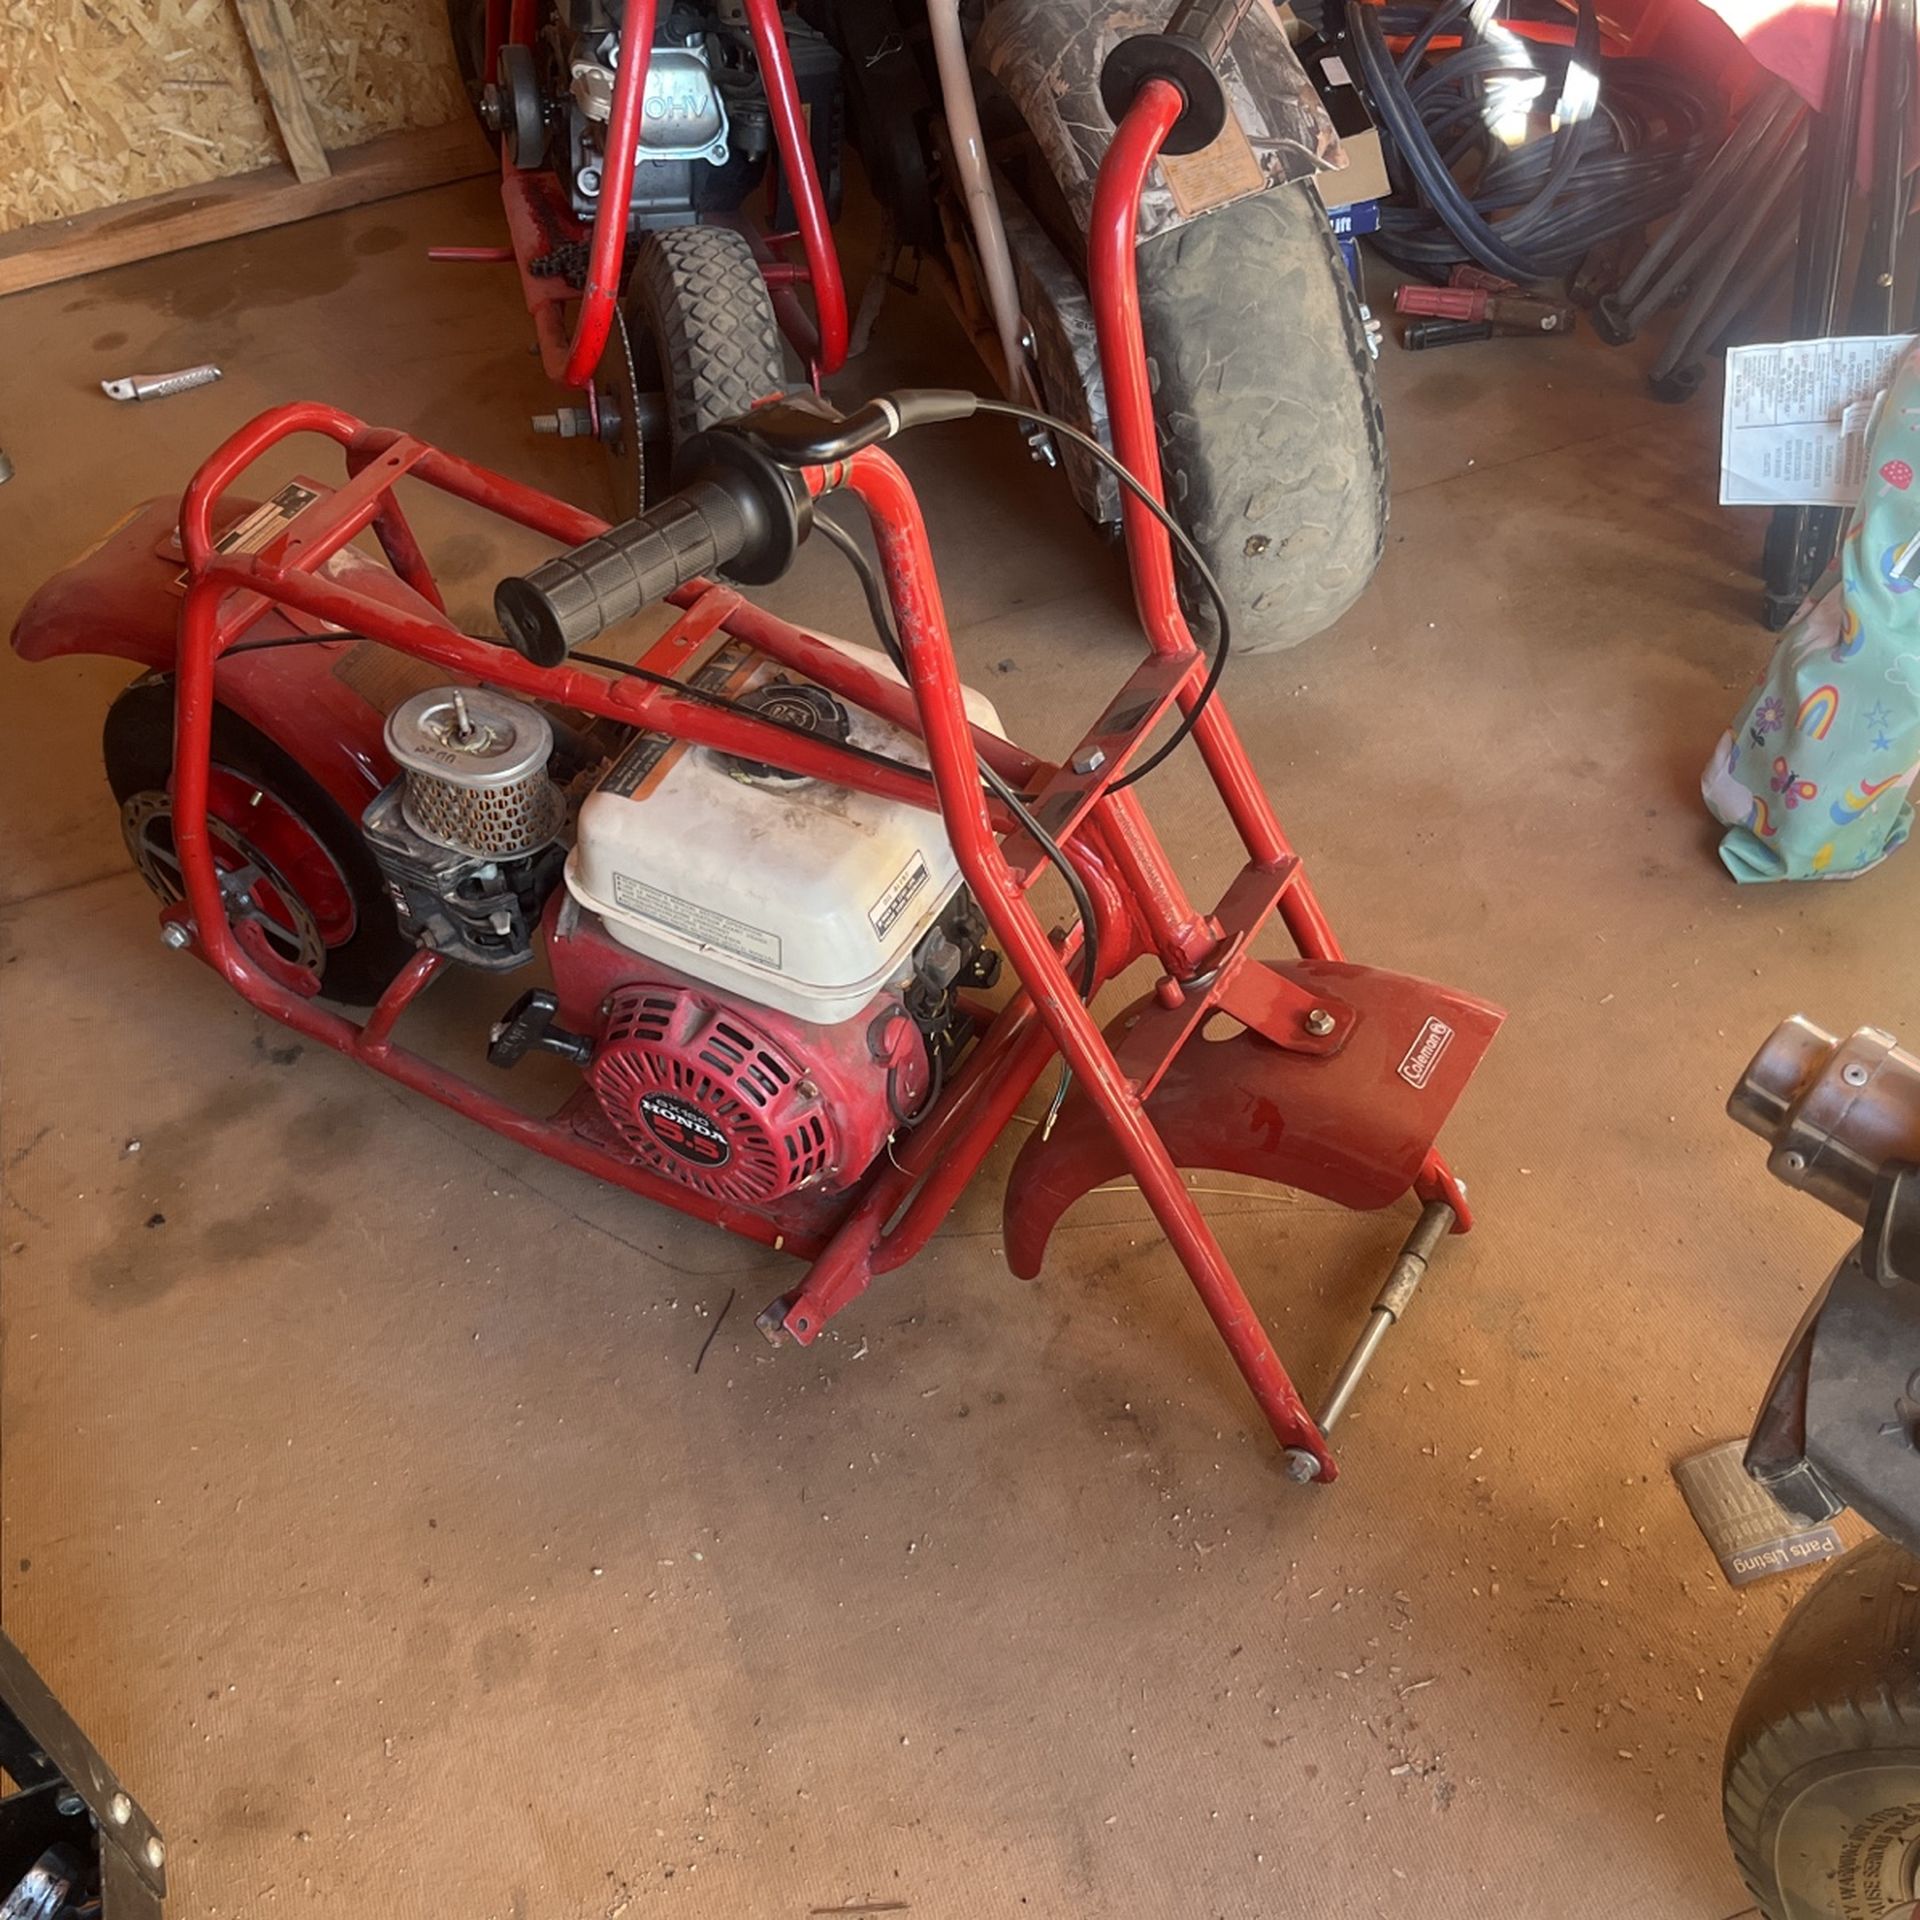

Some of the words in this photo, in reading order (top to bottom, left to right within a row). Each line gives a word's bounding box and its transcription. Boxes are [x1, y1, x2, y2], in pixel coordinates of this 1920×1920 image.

[645, 95, 708, 119] OHV
[1403, 1033, 1442, 1079] Coleman
[641, 1099, 728, 1145] HONDA
[653, 1115, 719, 1159] 5.5
[1732, 1548, 1790, 1574] Listing
[1789, 1537, 1835, 1557] Parts
[1864, 1881, 1885, 1920] AUSE
